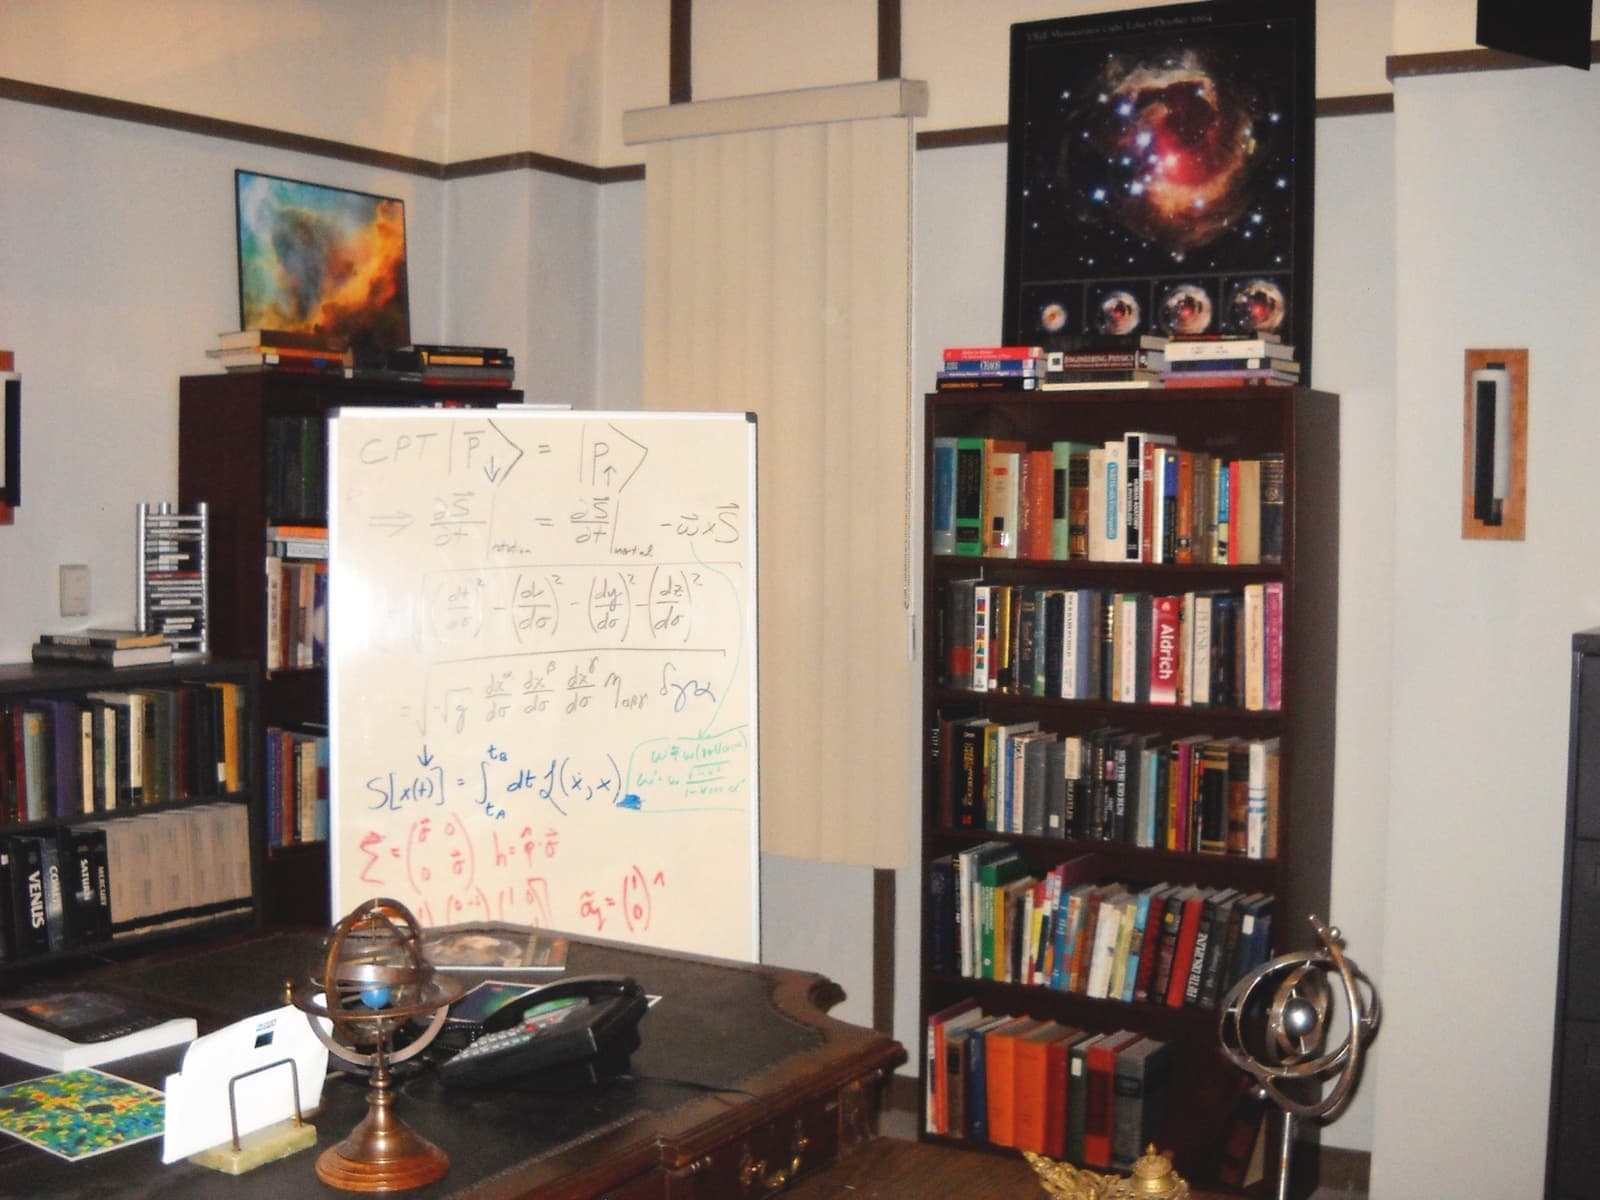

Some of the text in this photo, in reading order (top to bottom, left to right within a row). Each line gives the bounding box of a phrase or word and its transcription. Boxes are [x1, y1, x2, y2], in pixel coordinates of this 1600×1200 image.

[1159, 623, 1175, 680] Aldrich
[29, 870, 45, 928] VENUS
[80, 859, 92, 901] SATURN
